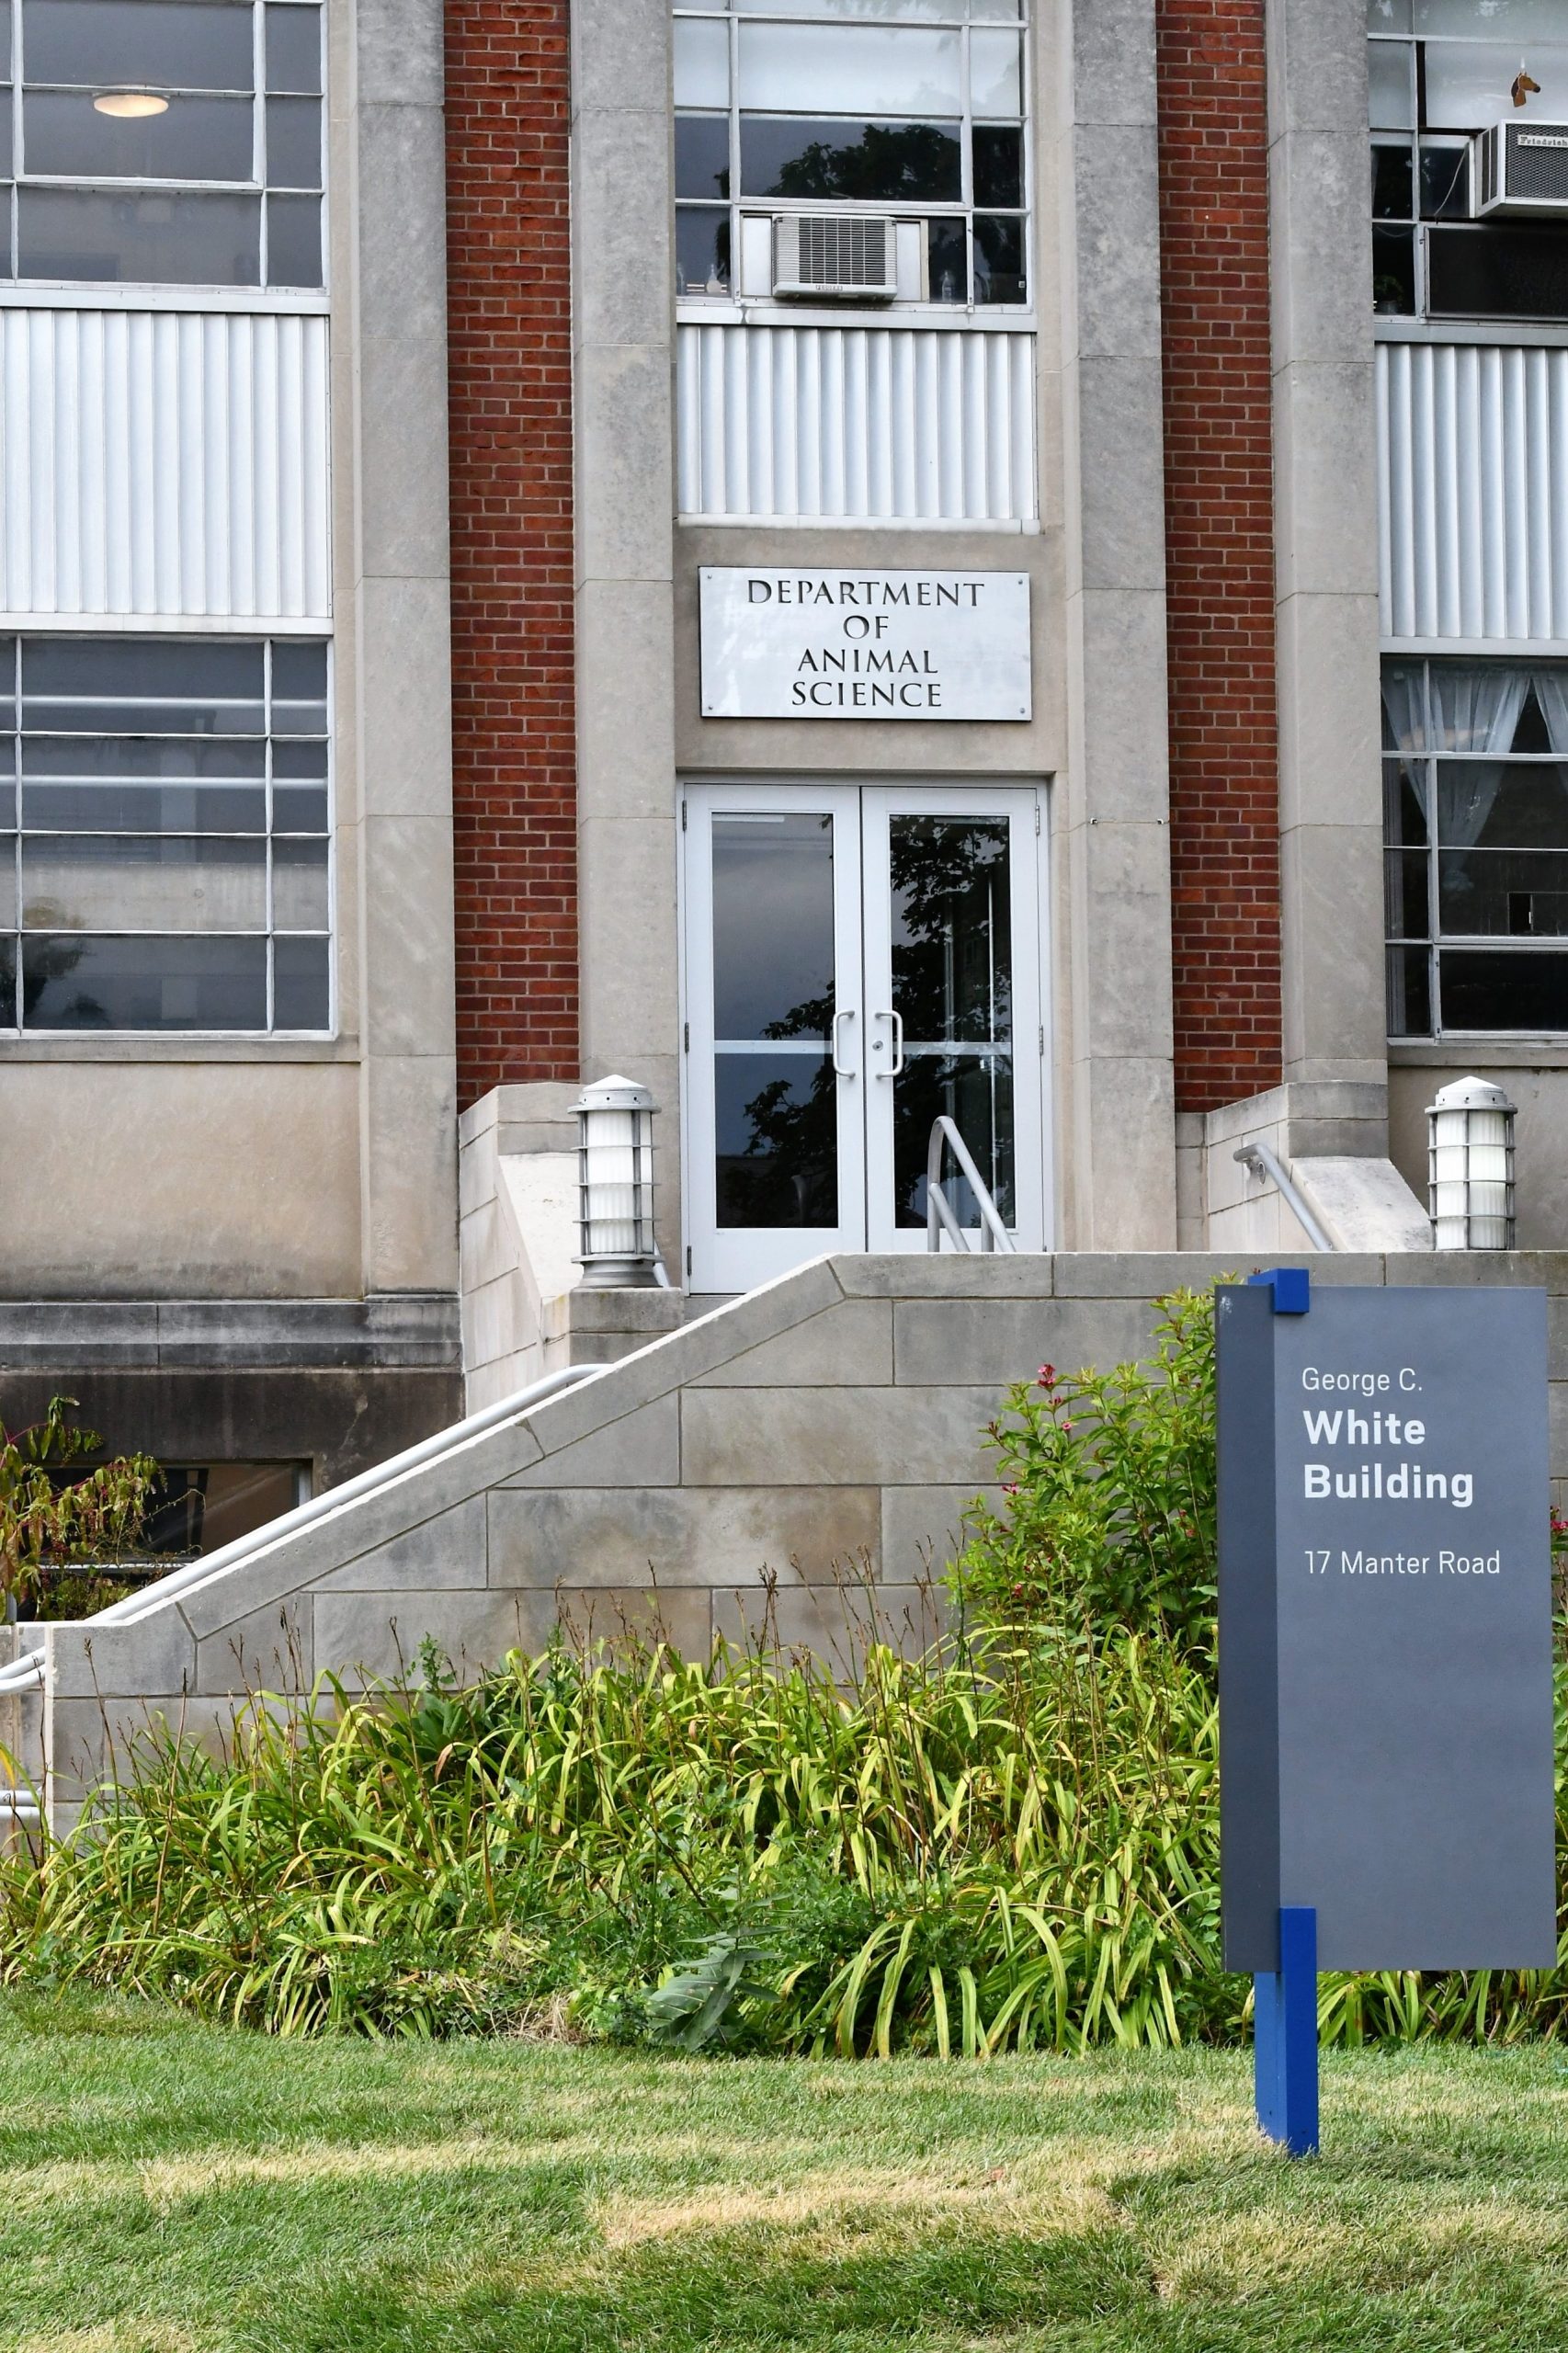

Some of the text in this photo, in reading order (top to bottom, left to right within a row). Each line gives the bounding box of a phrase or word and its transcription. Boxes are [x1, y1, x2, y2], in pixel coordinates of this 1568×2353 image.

[747, 579, 984, 607] DEPARTMENT
[843, 615, 889, 640] OF
[798, 648, 938, 674] ANIMAL
[791, 681, 942, 707] SCIENCE
[1301, 1367, 1423, 1396] George C.
[1302, 1409, 1426, 1445] White
[1303, 1462, 1473, 1507] Building
[1304, 1550, 1500, 1574] 17 Manter Road
